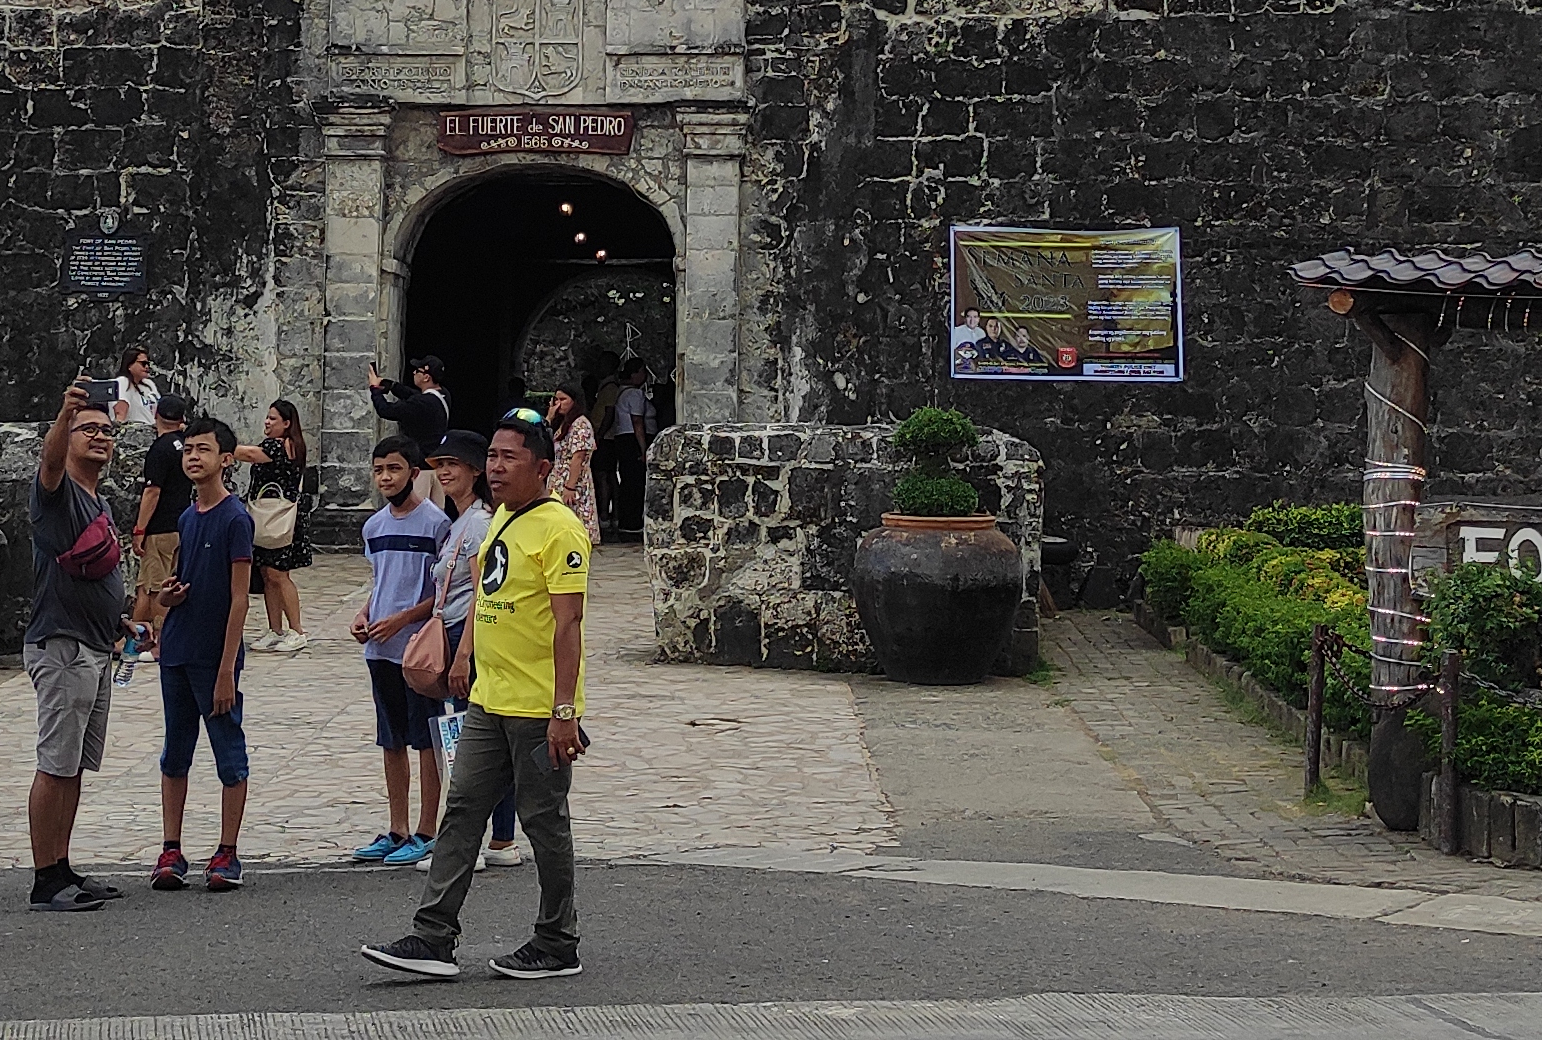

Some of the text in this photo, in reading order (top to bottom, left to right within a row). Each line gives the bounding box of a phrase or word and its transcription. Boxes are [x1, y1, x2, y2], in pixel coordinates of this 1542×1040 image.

[446, 115, 625, 136] EL FUERTE de SAN PEDRO
[521, 135, 548, 148] 1565
[966, 247, 1072, 268] SEMANA
[1014, 272, 1085, 289] SANTA
[1020, 294, 1070, 311] 2023
